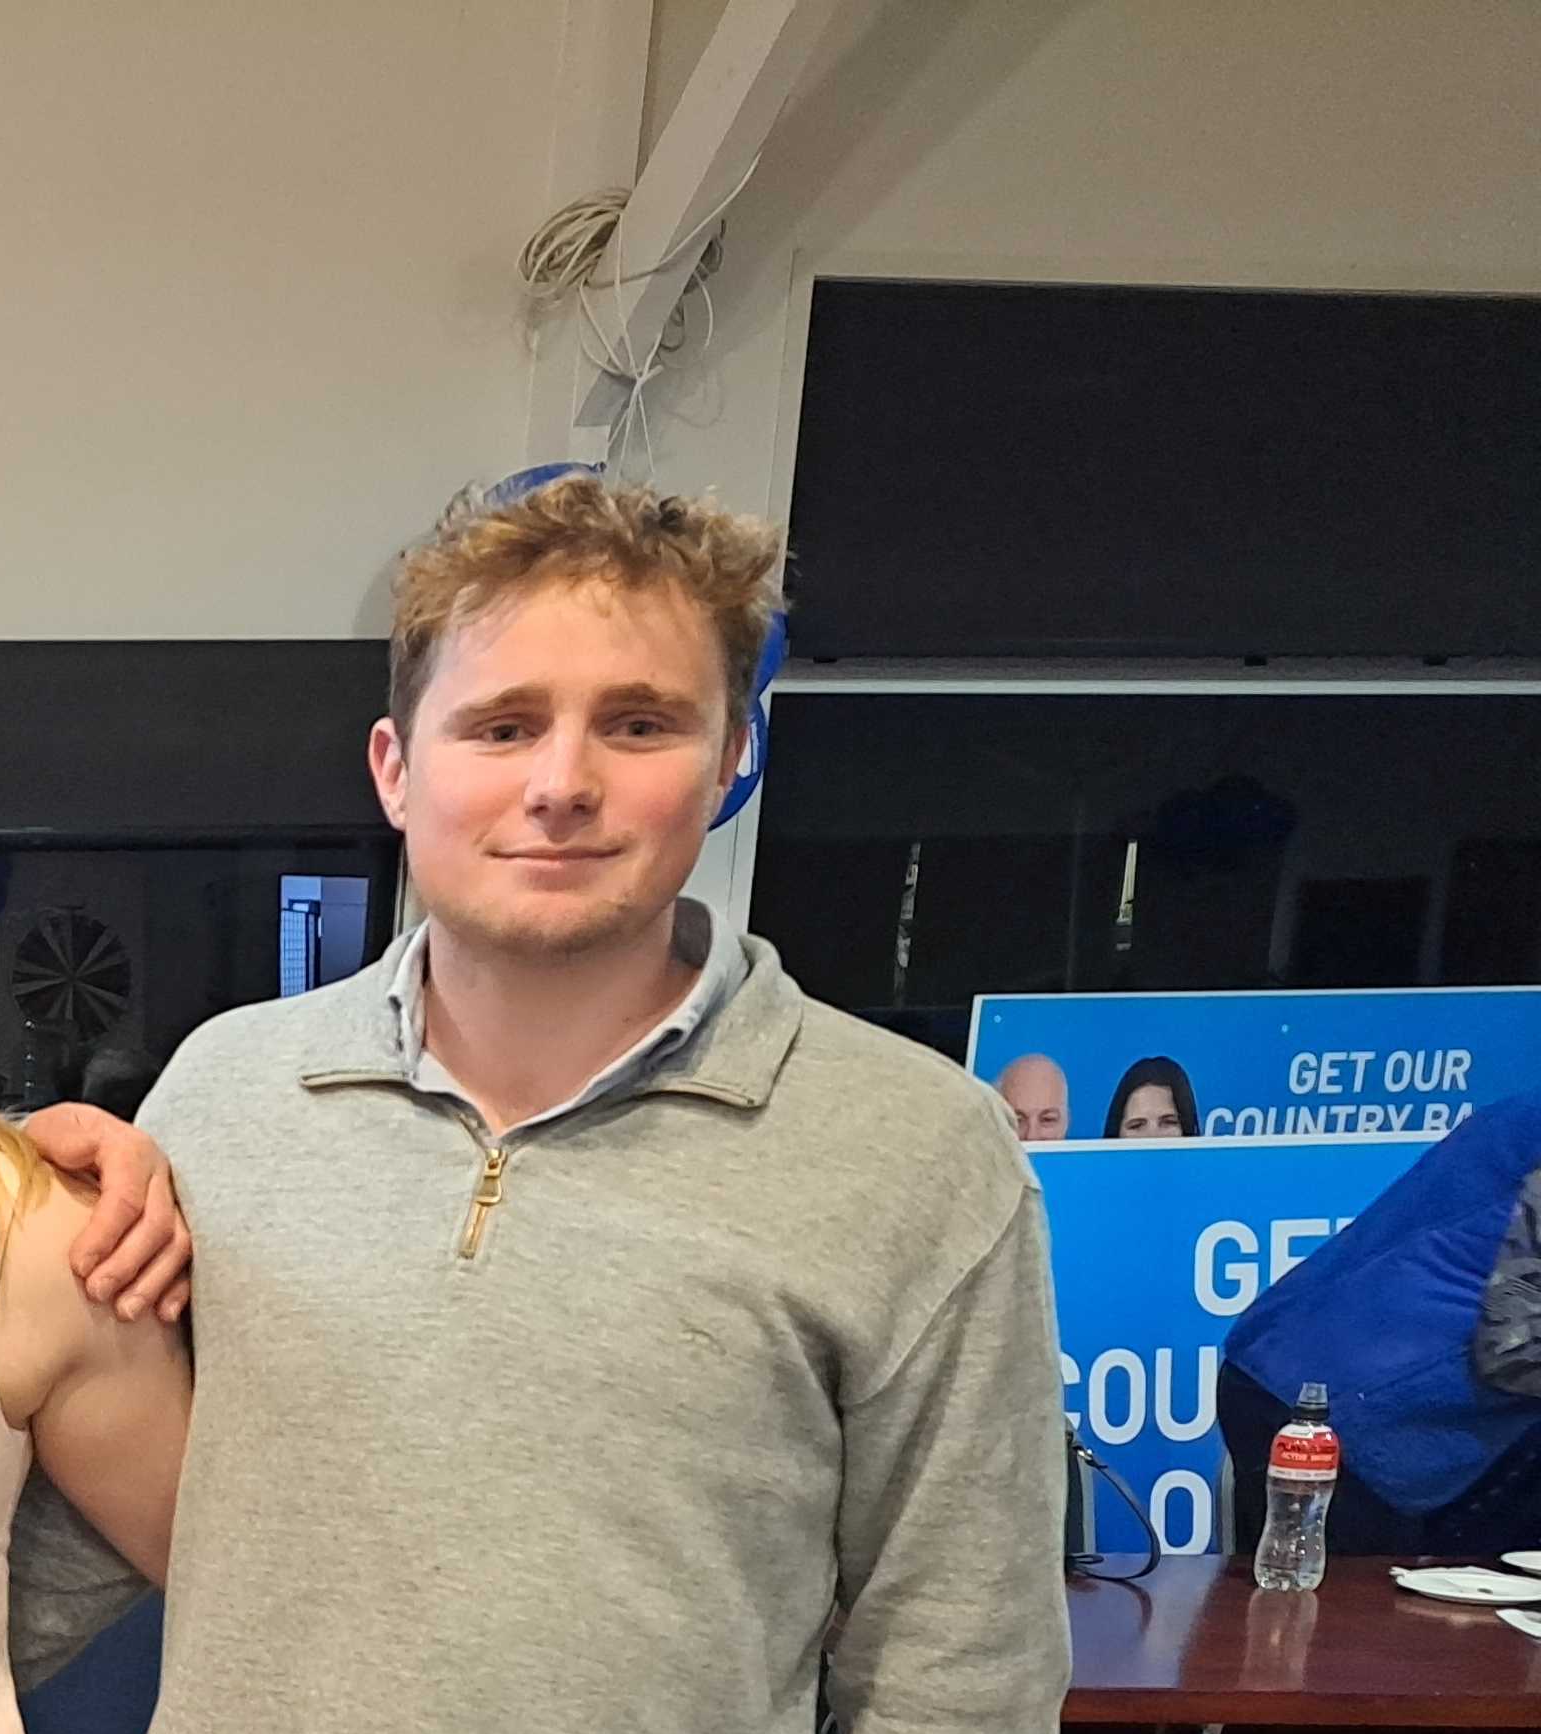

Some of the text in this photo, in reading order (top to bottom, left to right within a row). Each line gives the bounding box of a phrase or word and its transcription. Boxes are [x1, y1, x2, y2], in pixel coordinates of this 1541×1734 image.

[1289, 1048, 1471, 1094] GET OUR
[1204, 1103, 1413, 1137] COUNTRY
[1194, 1217, 1357, 1316] GE
